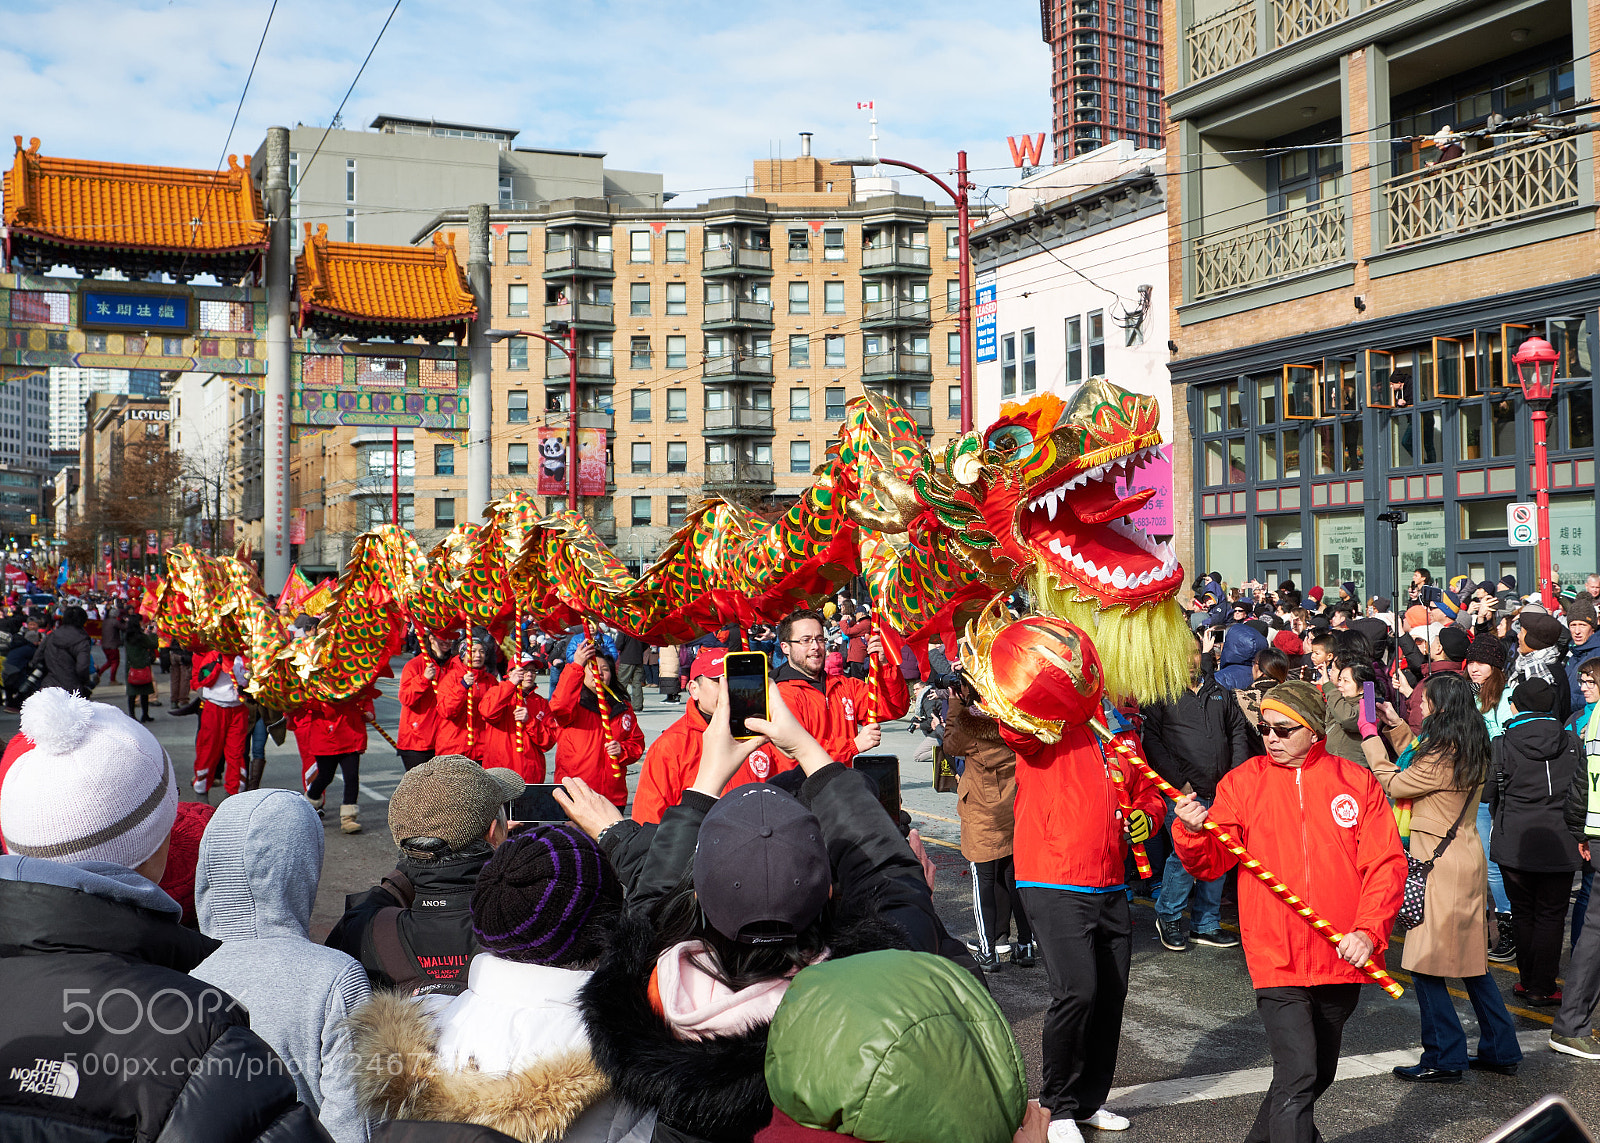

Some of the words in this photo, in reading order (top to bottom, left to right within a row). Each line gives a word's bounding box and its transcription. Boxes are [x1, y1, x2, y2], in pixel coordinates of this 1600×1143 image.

[1007, 133, 1045, 167] W
[976, 302, 997, 317] LEASED
[131, 410, 170, 420] LOTUS
[34, 1058, 62, 1073] THE
[9, 1067, 60, 1084] NORTH
[19, 1080, 56, 1095] FACE
